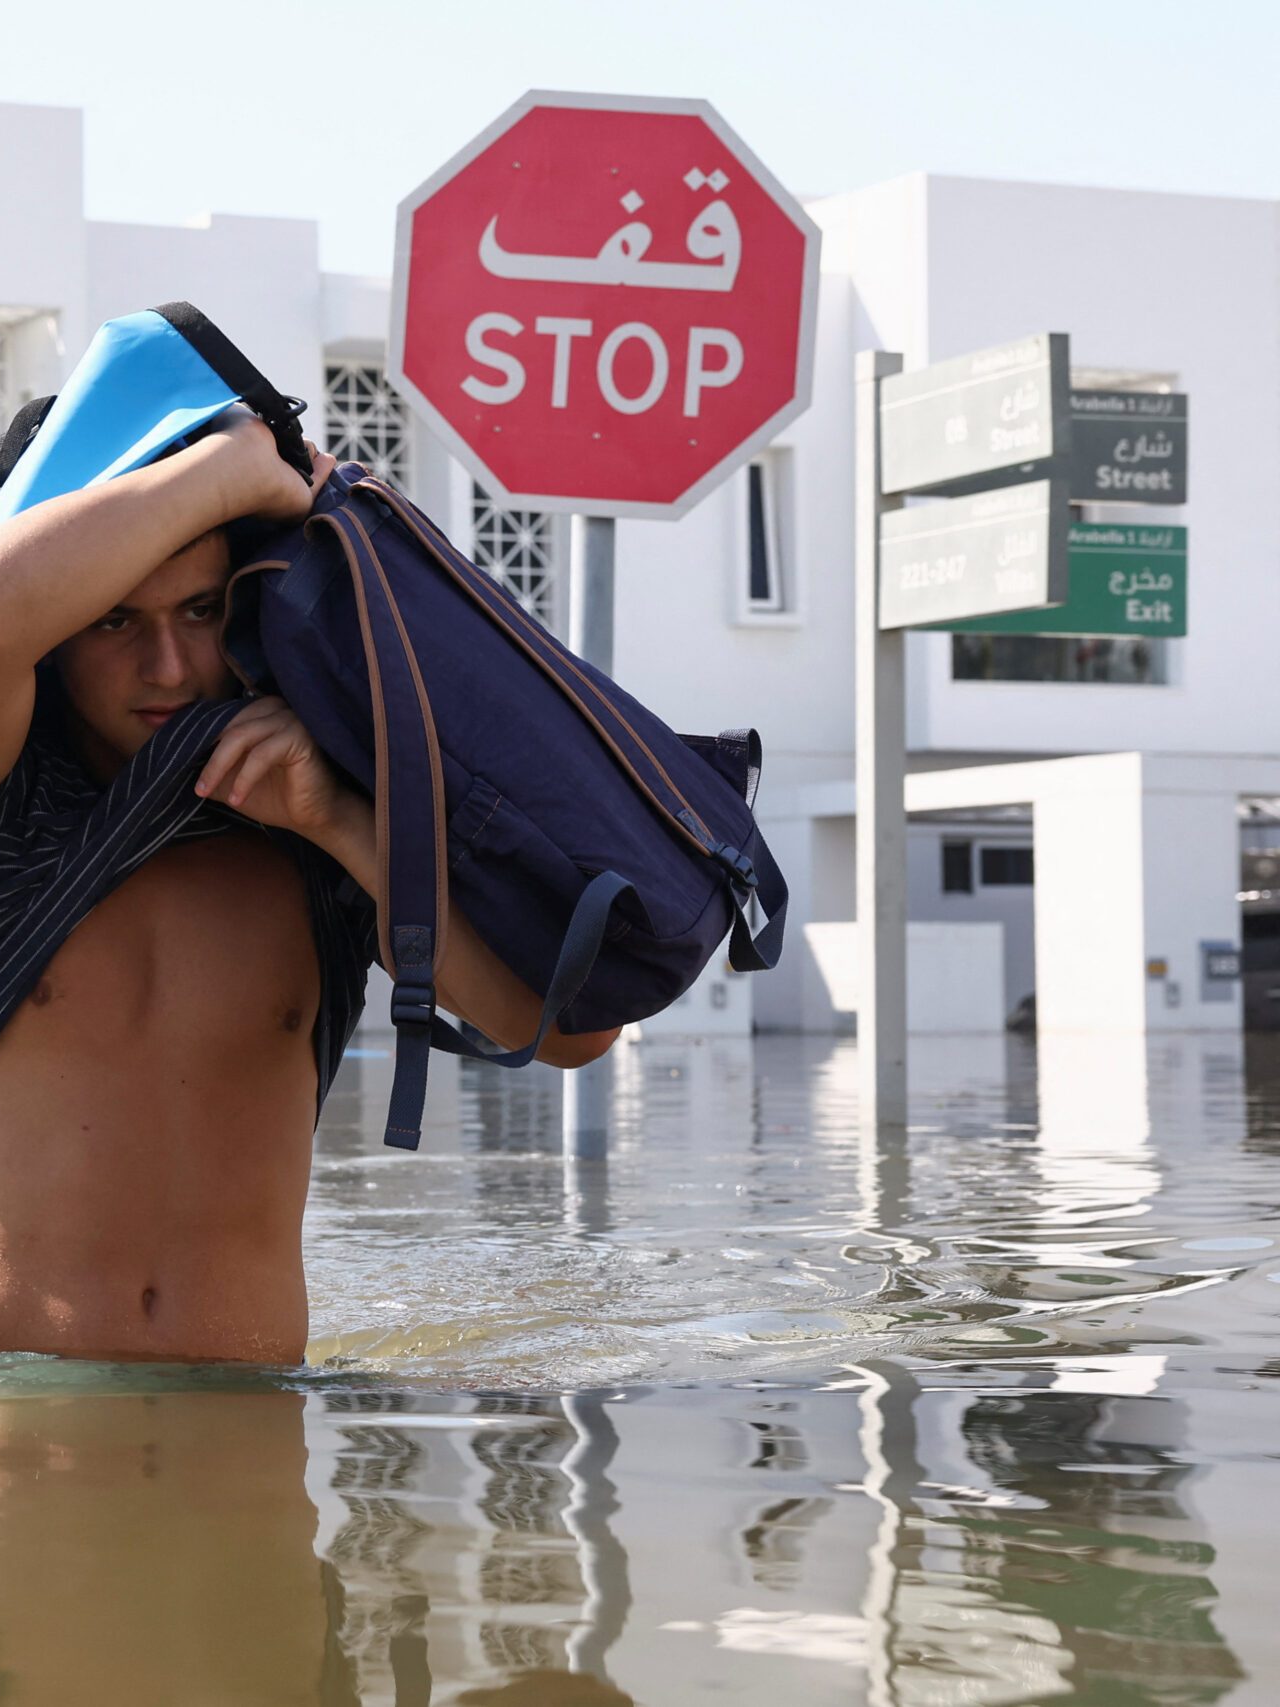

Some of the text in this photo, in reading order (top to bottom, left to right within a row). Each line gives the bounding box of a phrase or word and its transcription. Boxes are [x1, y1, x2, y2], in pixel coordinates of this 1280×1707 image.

[477, 166, 742, 292] قف
[460, 311, 745, 418] STOP
[991, 422, 1039, 452] Street
[1113, 430, 1173, 462] شارع
[1096, 464, 1172, 489] Street
[1109, 566, 1173, 595] مخرج
[1127, 599, 1172, 622] Exit
